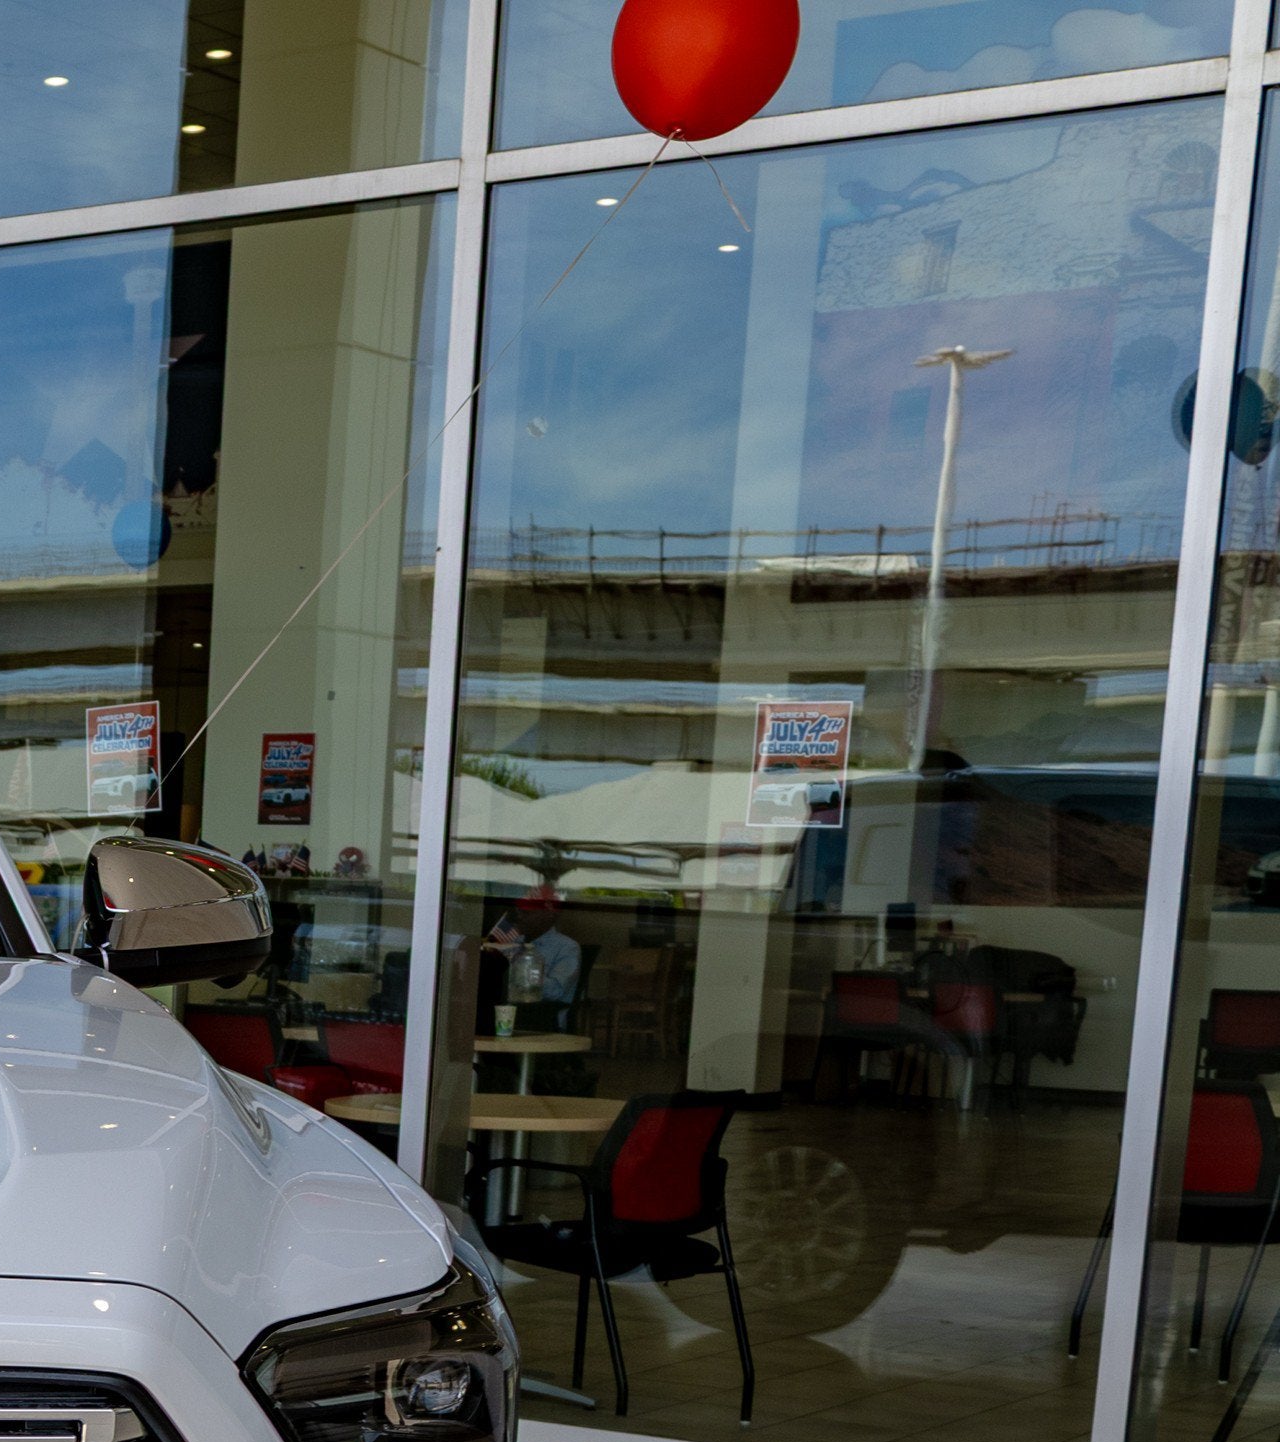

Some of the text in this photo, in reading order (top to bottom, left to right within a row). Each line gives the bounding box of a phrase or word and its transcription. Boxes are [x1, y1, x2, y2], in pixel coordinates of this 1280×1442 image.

[95, 714, 155, 741] JULY 4TH
[766, 715, 845, 742] JULY 4TH
[92, 736, 151, 753] CELEBRATION
[760, 741, 837, 756] CELEBRATION
[266, 748, 293, 761] JULY
[263, 759, 309, 769] CELEBRATION
